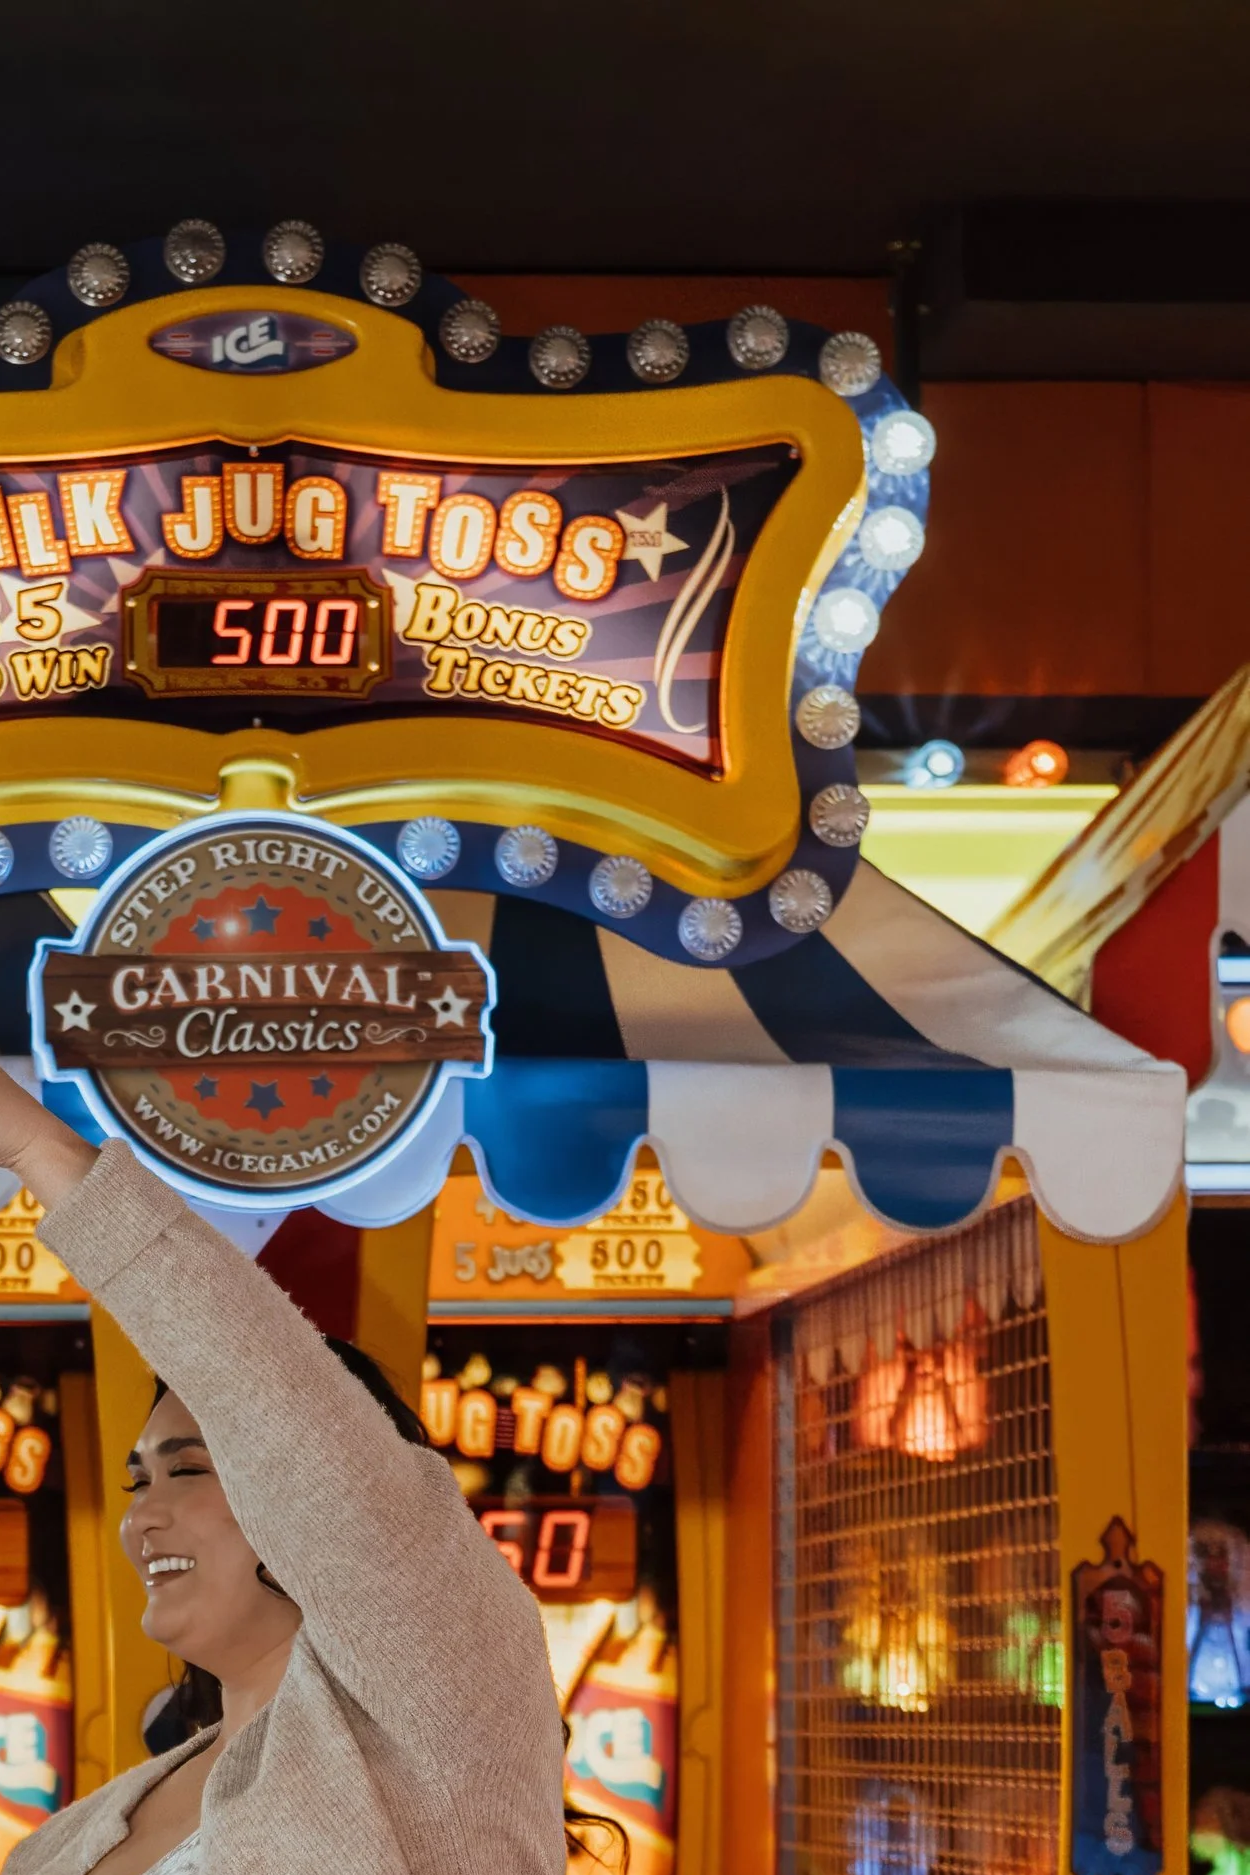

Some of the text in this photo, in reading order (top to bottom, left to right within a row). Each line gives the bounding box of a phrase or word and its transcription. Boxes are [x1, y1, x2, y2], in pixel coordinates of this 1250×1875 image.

[212, 316, 284, 364] ICE
[163, 463, 347, 560] JUG
[378, 471, 625, 601] TOSS
[16, 582, 64, 640] 5
[211, 600, 357, 664] 500
[110, 839, 417, 949] STEP RIGHT UP!
[112, 963, 416, 1011] CARNIVAL
[176, 1009, 362, 1058] Classics
[133, 1093, 403, 1175] WWW.ICEGAME.COM
[454, 1241, 553, 1281] 5 JUGS
[591, 1239, 665, 1270] 500
[512, 1387, 662, 1490] TOSS
